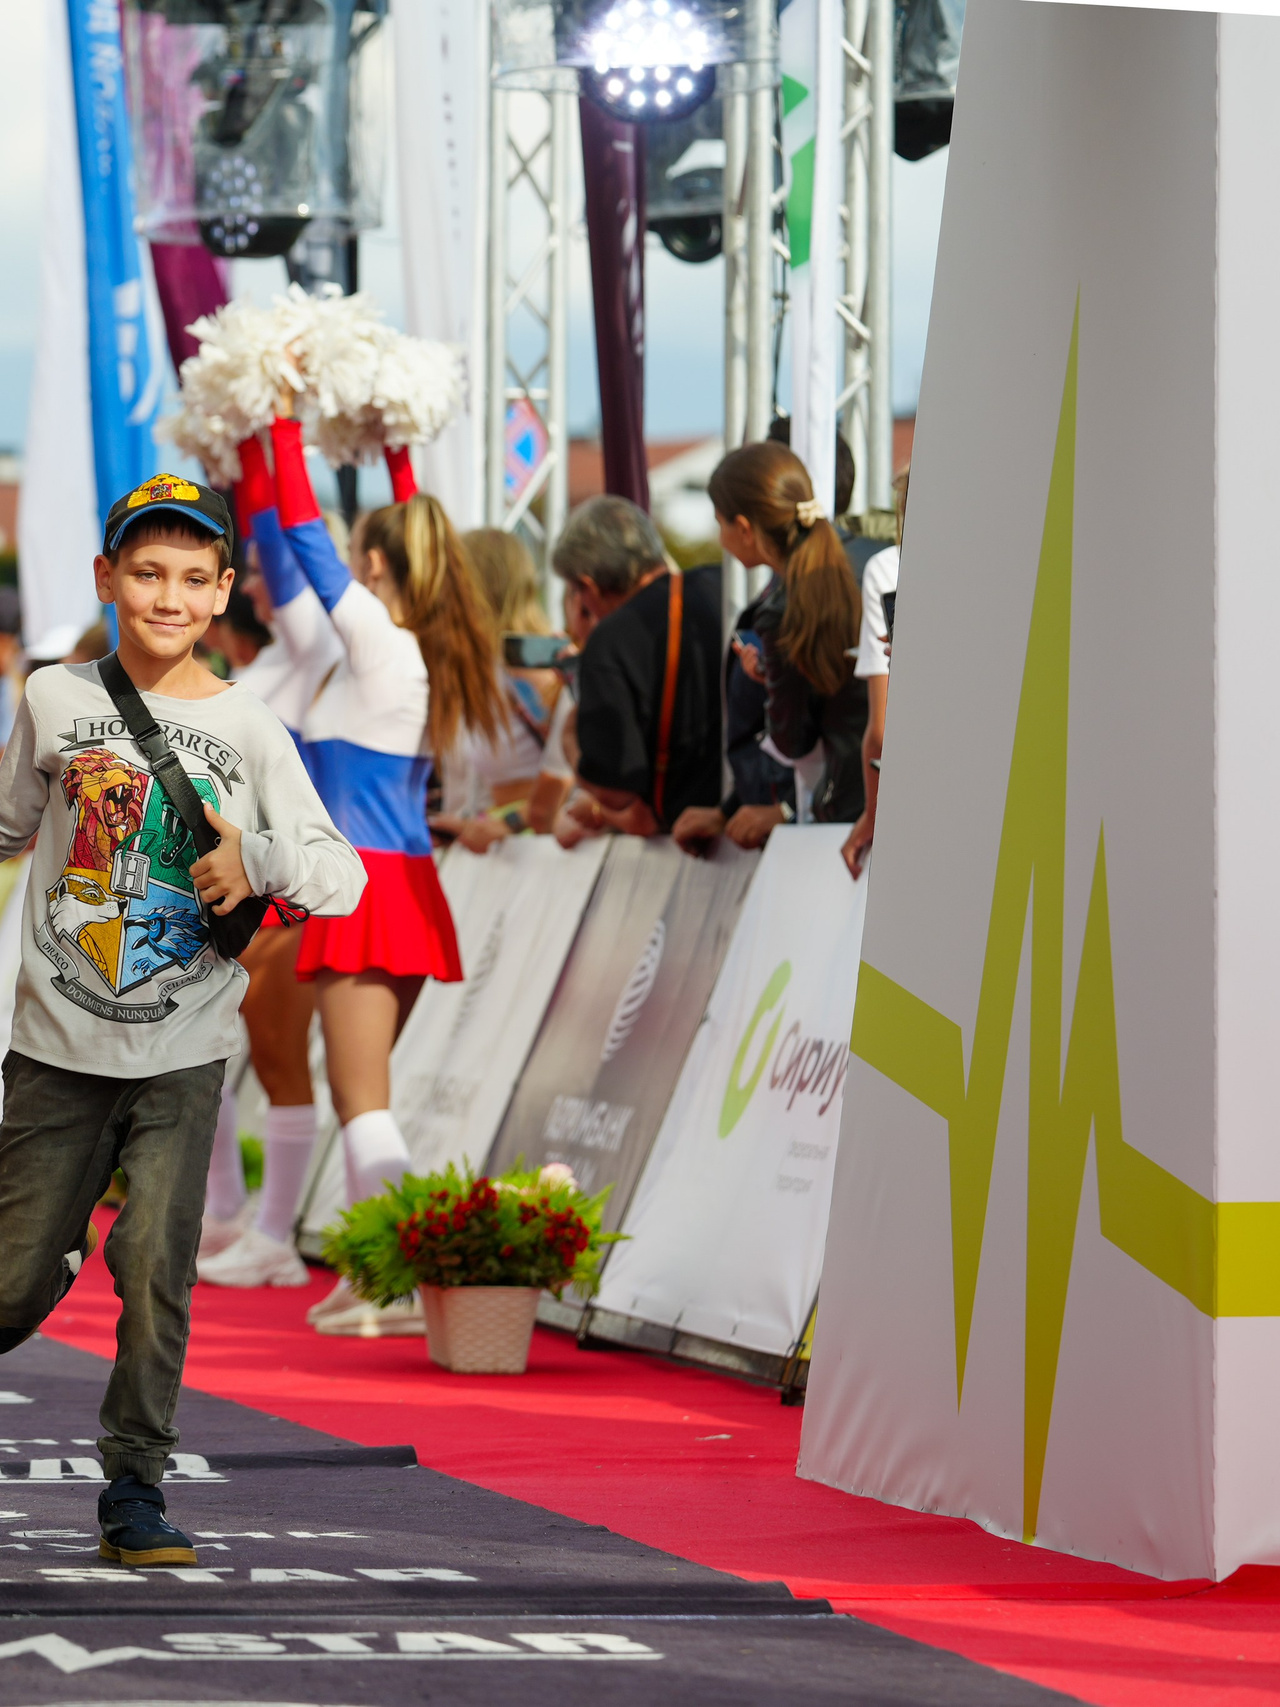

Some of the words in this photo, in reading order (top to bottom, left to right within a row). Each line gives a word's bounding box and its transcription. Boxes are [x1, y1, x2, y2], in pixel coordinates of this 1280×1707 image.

[89, 720, 231, 767] HOARTS
[118, 856, 147, 893] H
[42, 942, 69, 970] DRACO
[66, 984, 113, 1016] DORMIENS
[770, 1019, 848, 1117] Сириу
[36, 1567, 482, 1583] STAR
[162, 1632, 655, 1655] STAR
